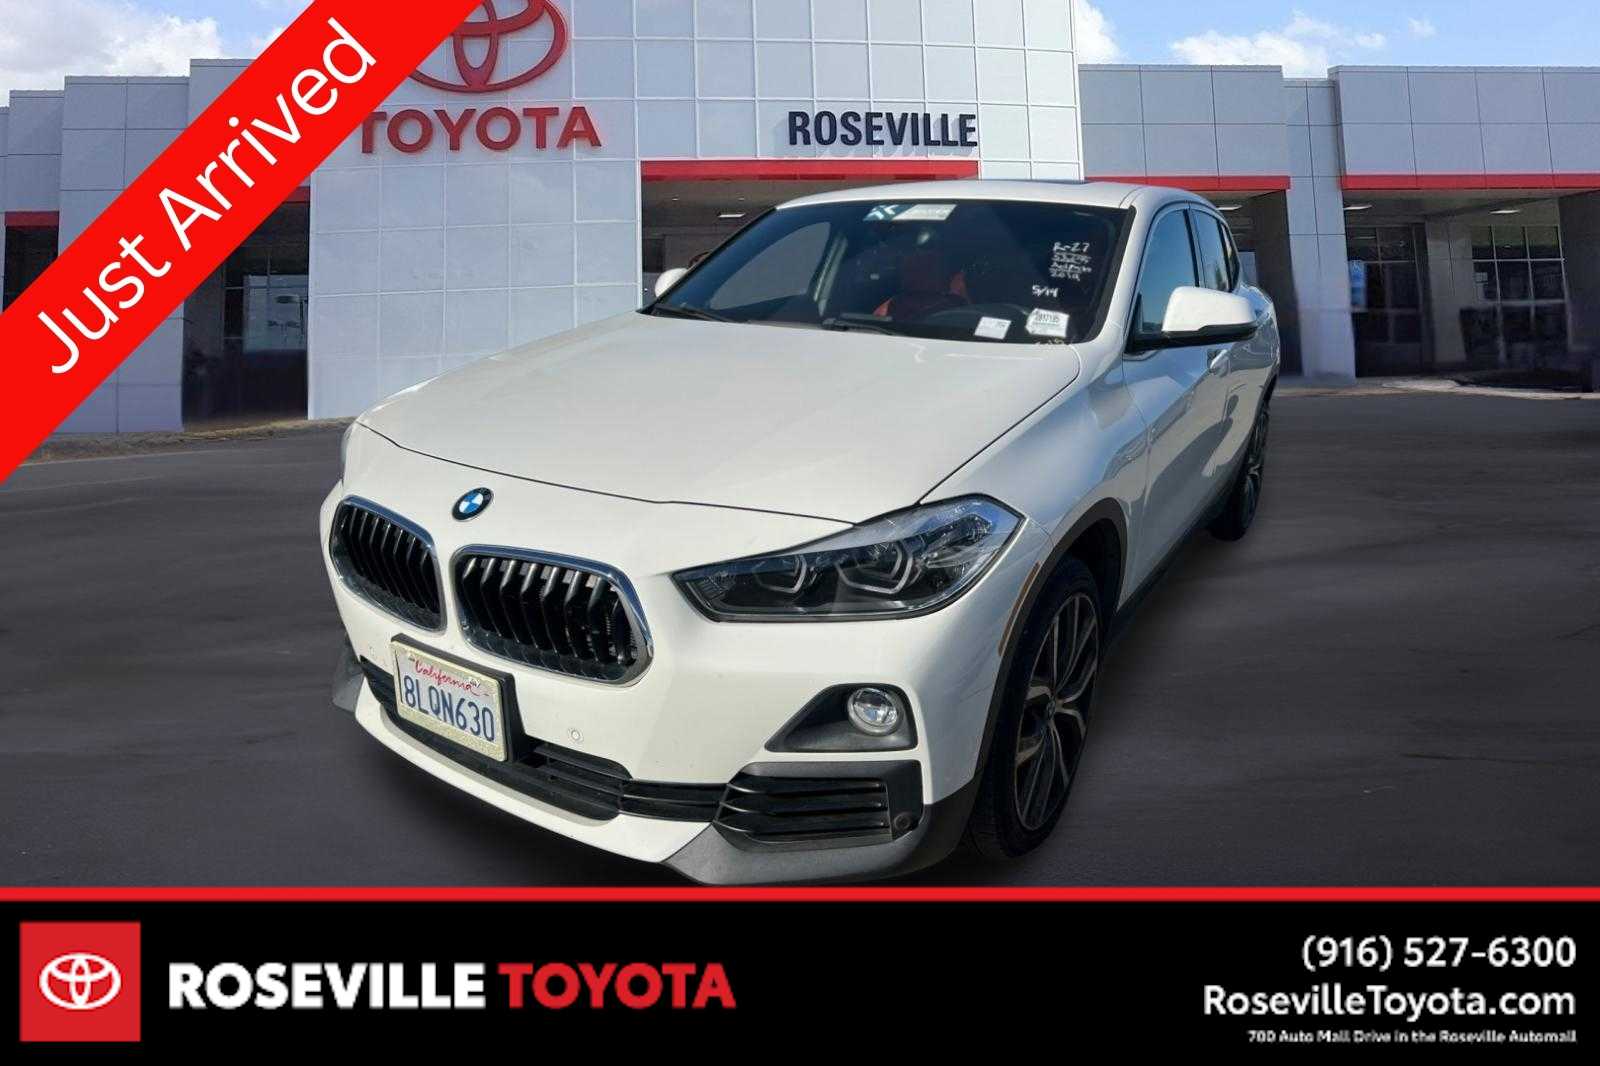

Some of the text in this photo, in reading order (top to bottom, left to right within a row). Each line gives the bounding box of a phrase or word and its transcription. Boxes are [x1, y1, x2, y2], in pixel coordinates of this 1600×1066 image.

[360, 106, 602, 155] TOYOTA
[788, 111, 978, 148] ROSEVILLE
[411, 658, 477, 693] California
[403, 674, 495, 742] 8LQN630
